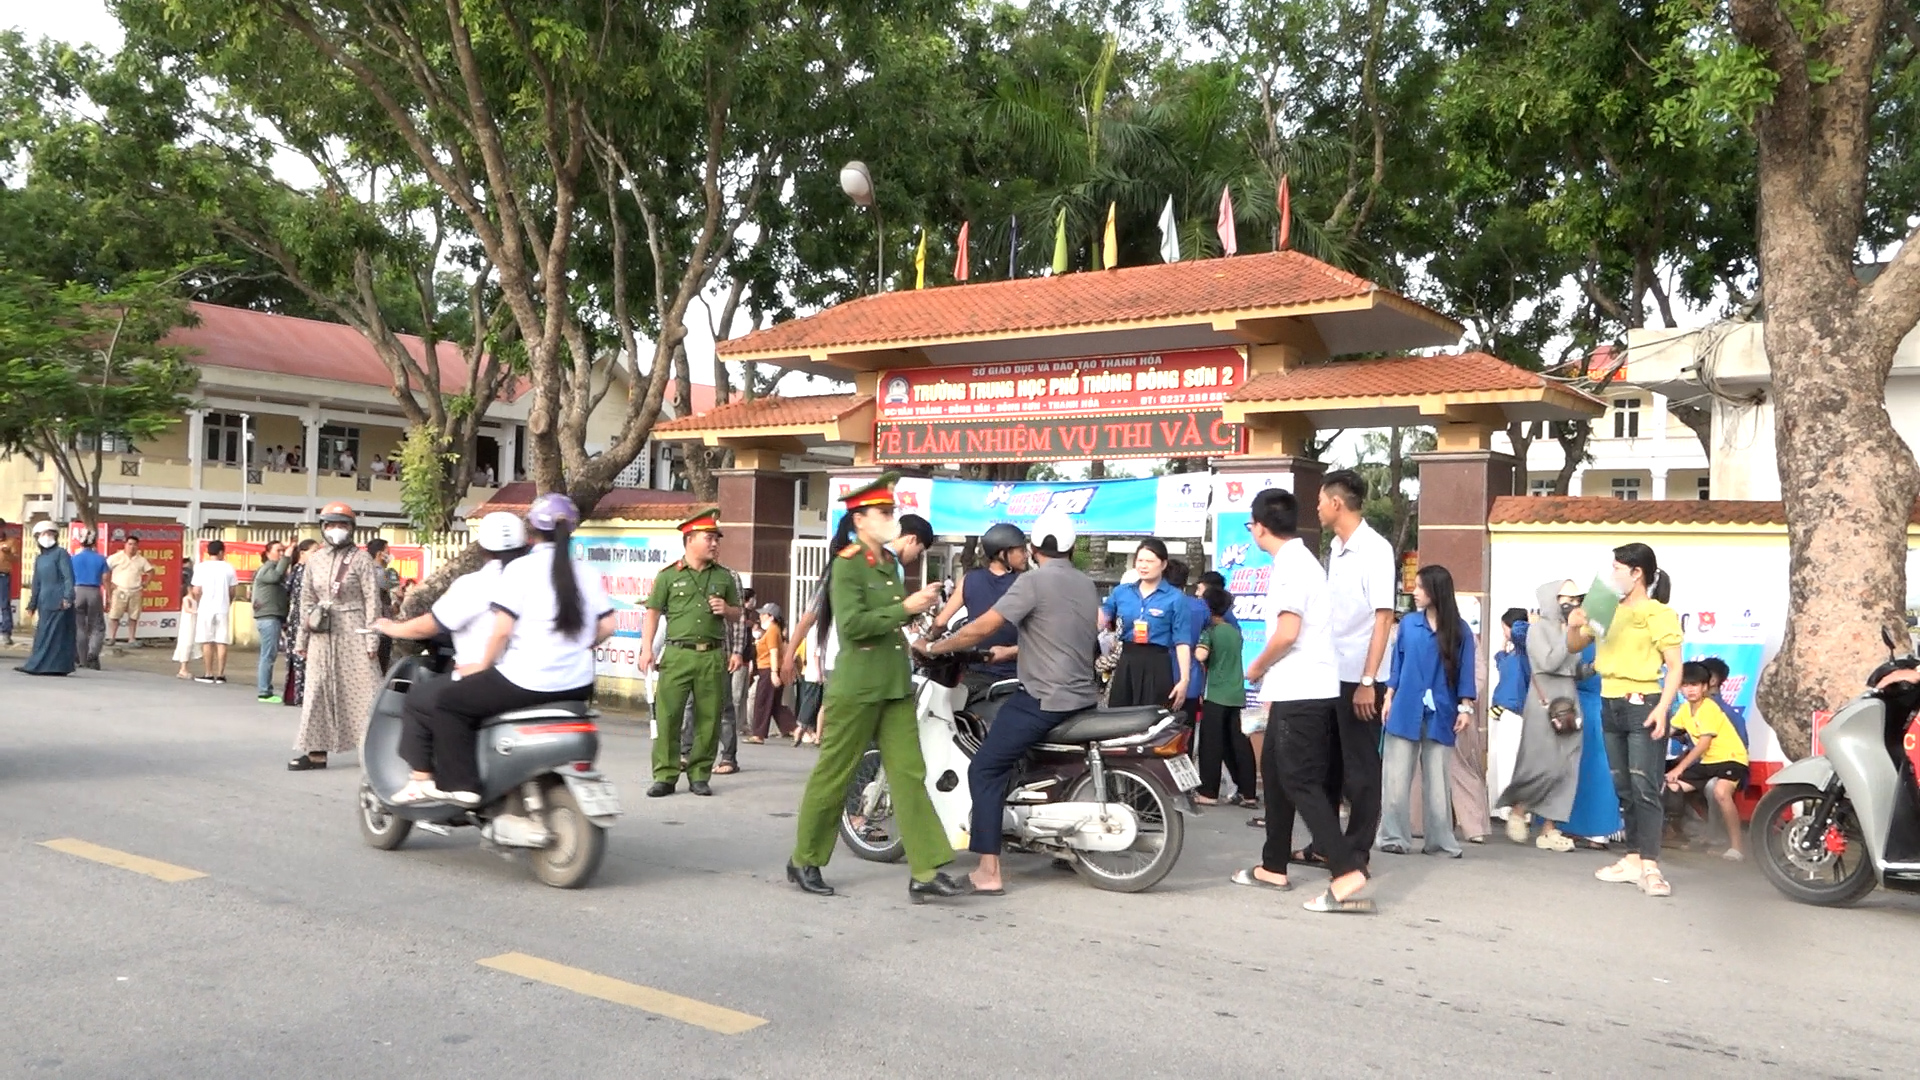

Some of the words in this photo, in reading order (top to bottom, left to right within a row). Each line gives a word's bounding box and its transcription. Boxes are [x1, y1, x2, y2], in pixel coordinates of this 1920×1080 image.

[1014, 364, 1035, 376] DỤC
[1077, 359, 1098, 371] TẠO
[1100, 357, 1137, 368] THANH
[913, 378, 967, 402] TRƯỜNG
[969, 380, 1015, 401] TRUNG
[1017, 378, 1047, 401] HỌC
[1049, 368, 1080, 396] PHỔ
[1082, 370, 1133, 394] THÔNG
[1136, 367, 1180, 391] ĐÔNG
[1183, 366, 1218, 388] SƠN
[1222, 366, 1234, 385] 2
[907, 424, 961, 454] LÀM
[966, 423, 1053, 457] NHIỆM
[1058, 424, 1098, 455] VỤ
[1103, 422, 1153, 449] THI
[1160, 412, 1203, 446] VÀ
[663, 550, 668, 563] 2
[1232, 595, 1266, 620] 202
[160, 618, 177, 628] 5G
